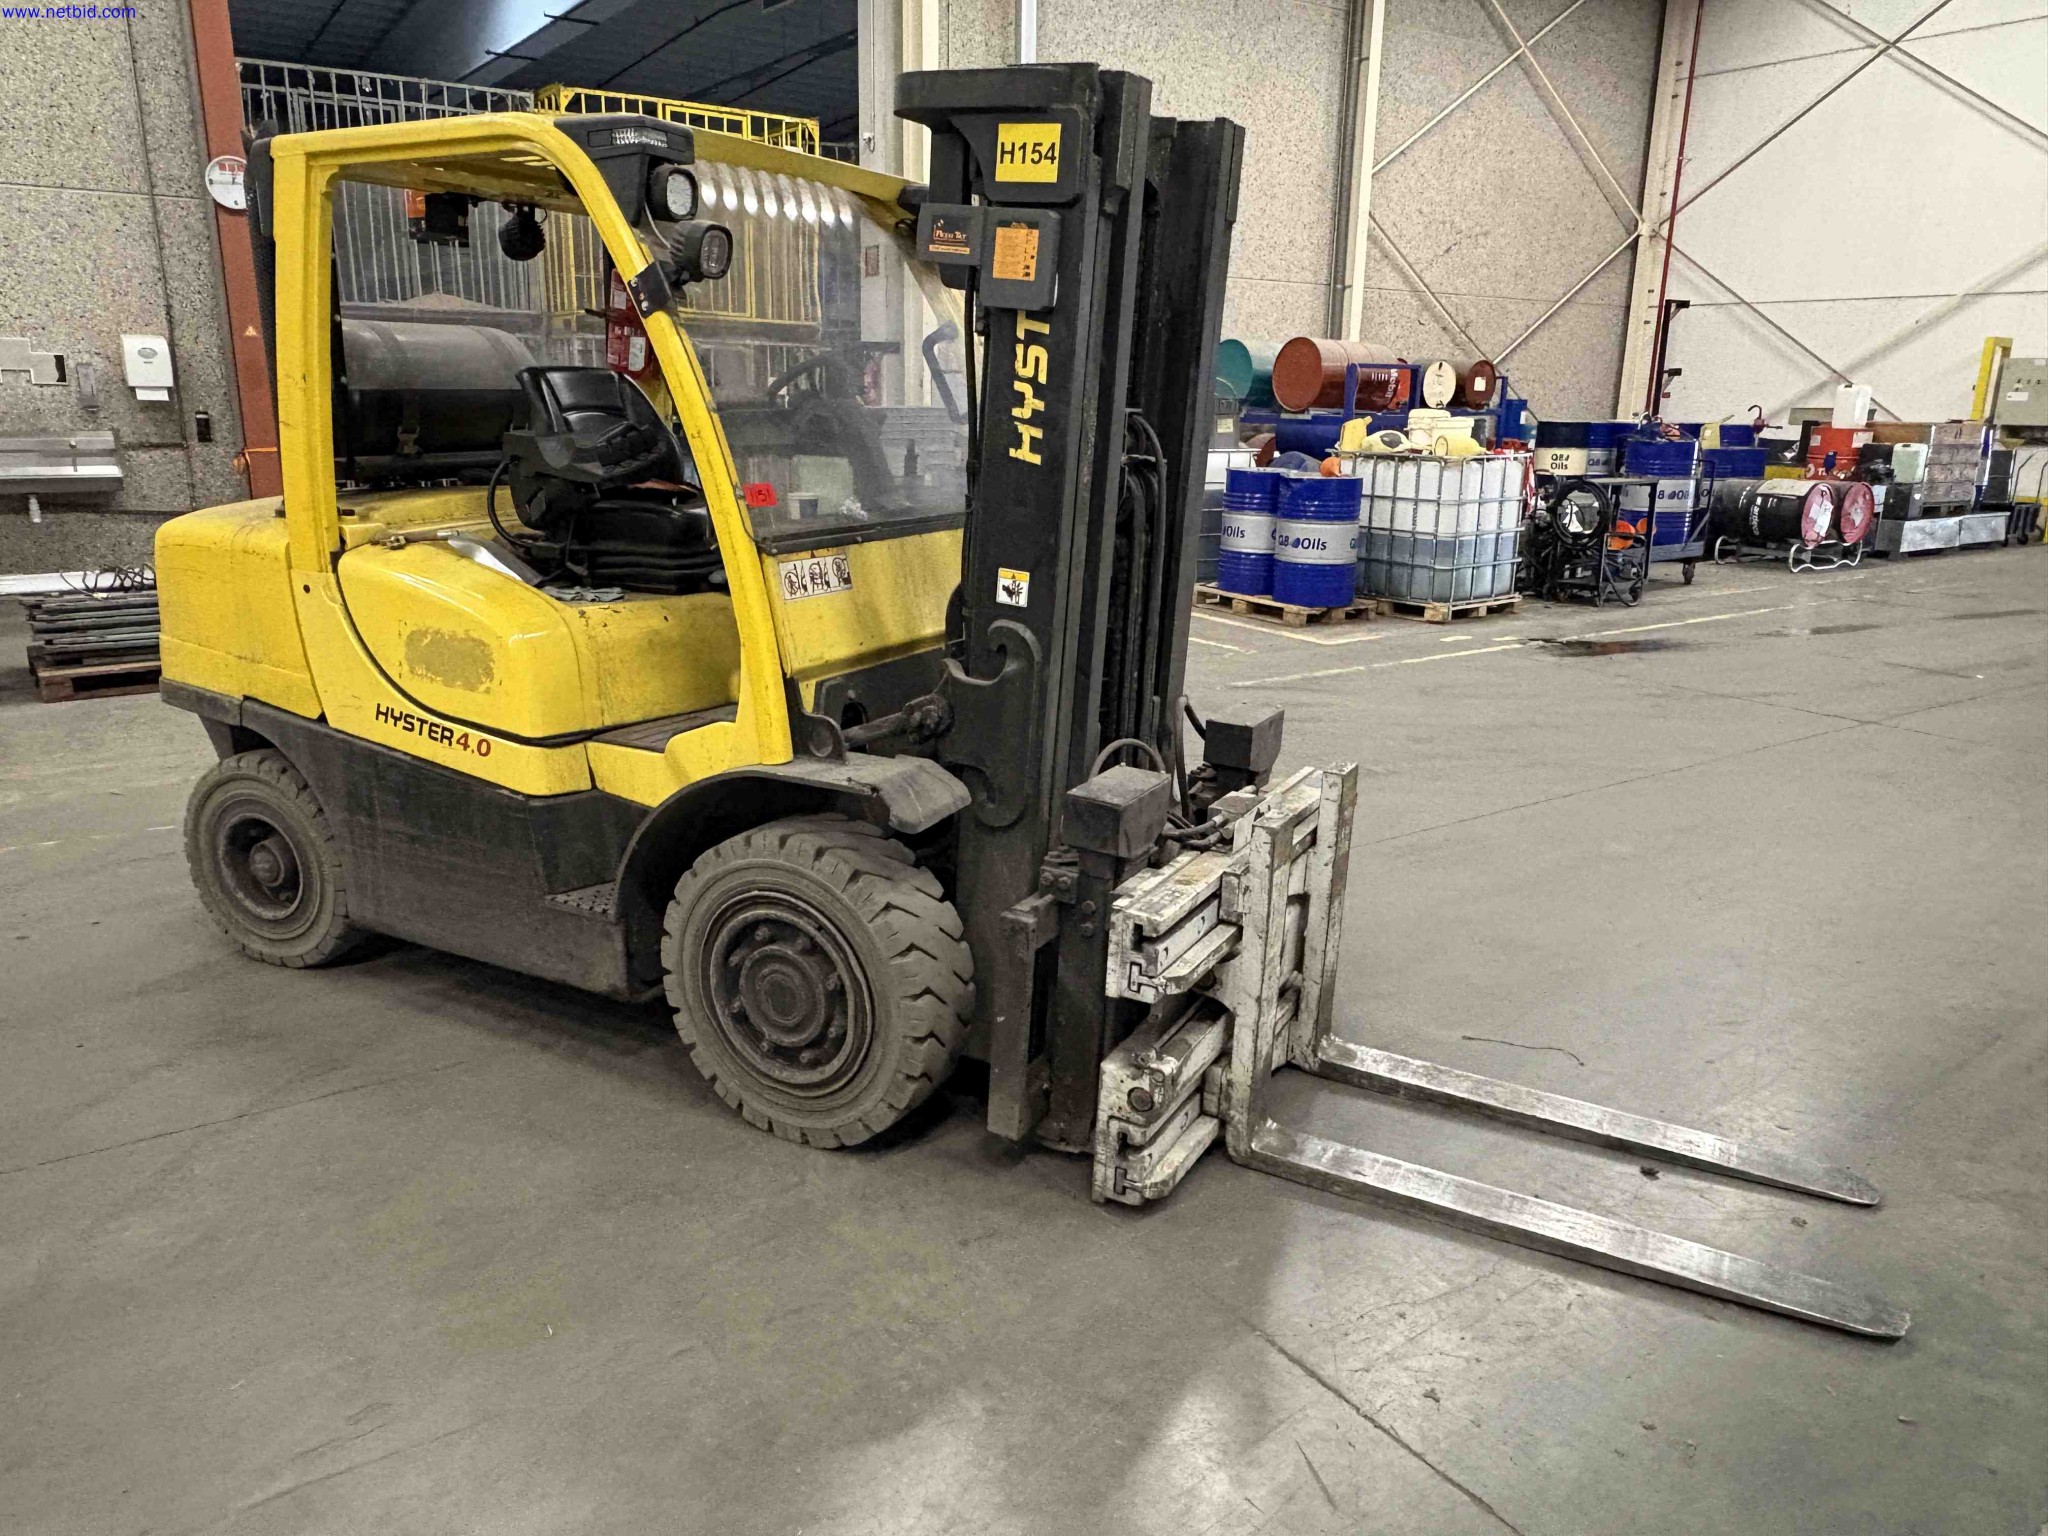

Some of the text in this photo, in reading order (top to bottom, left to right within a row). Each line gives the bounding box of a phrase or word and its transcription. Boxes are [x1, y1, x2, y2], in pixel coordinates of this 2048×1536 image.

[1000, 142, 1057, 165] H154
[1009, 310, 1050, 465] HYST
[1550, 462, 1568, 470] Oils
[1226, 526, 1246, 539] Oils
[1300, 537, 1327, 551] Oils
[375, 703, 491, 757] HYSTER 4.0
